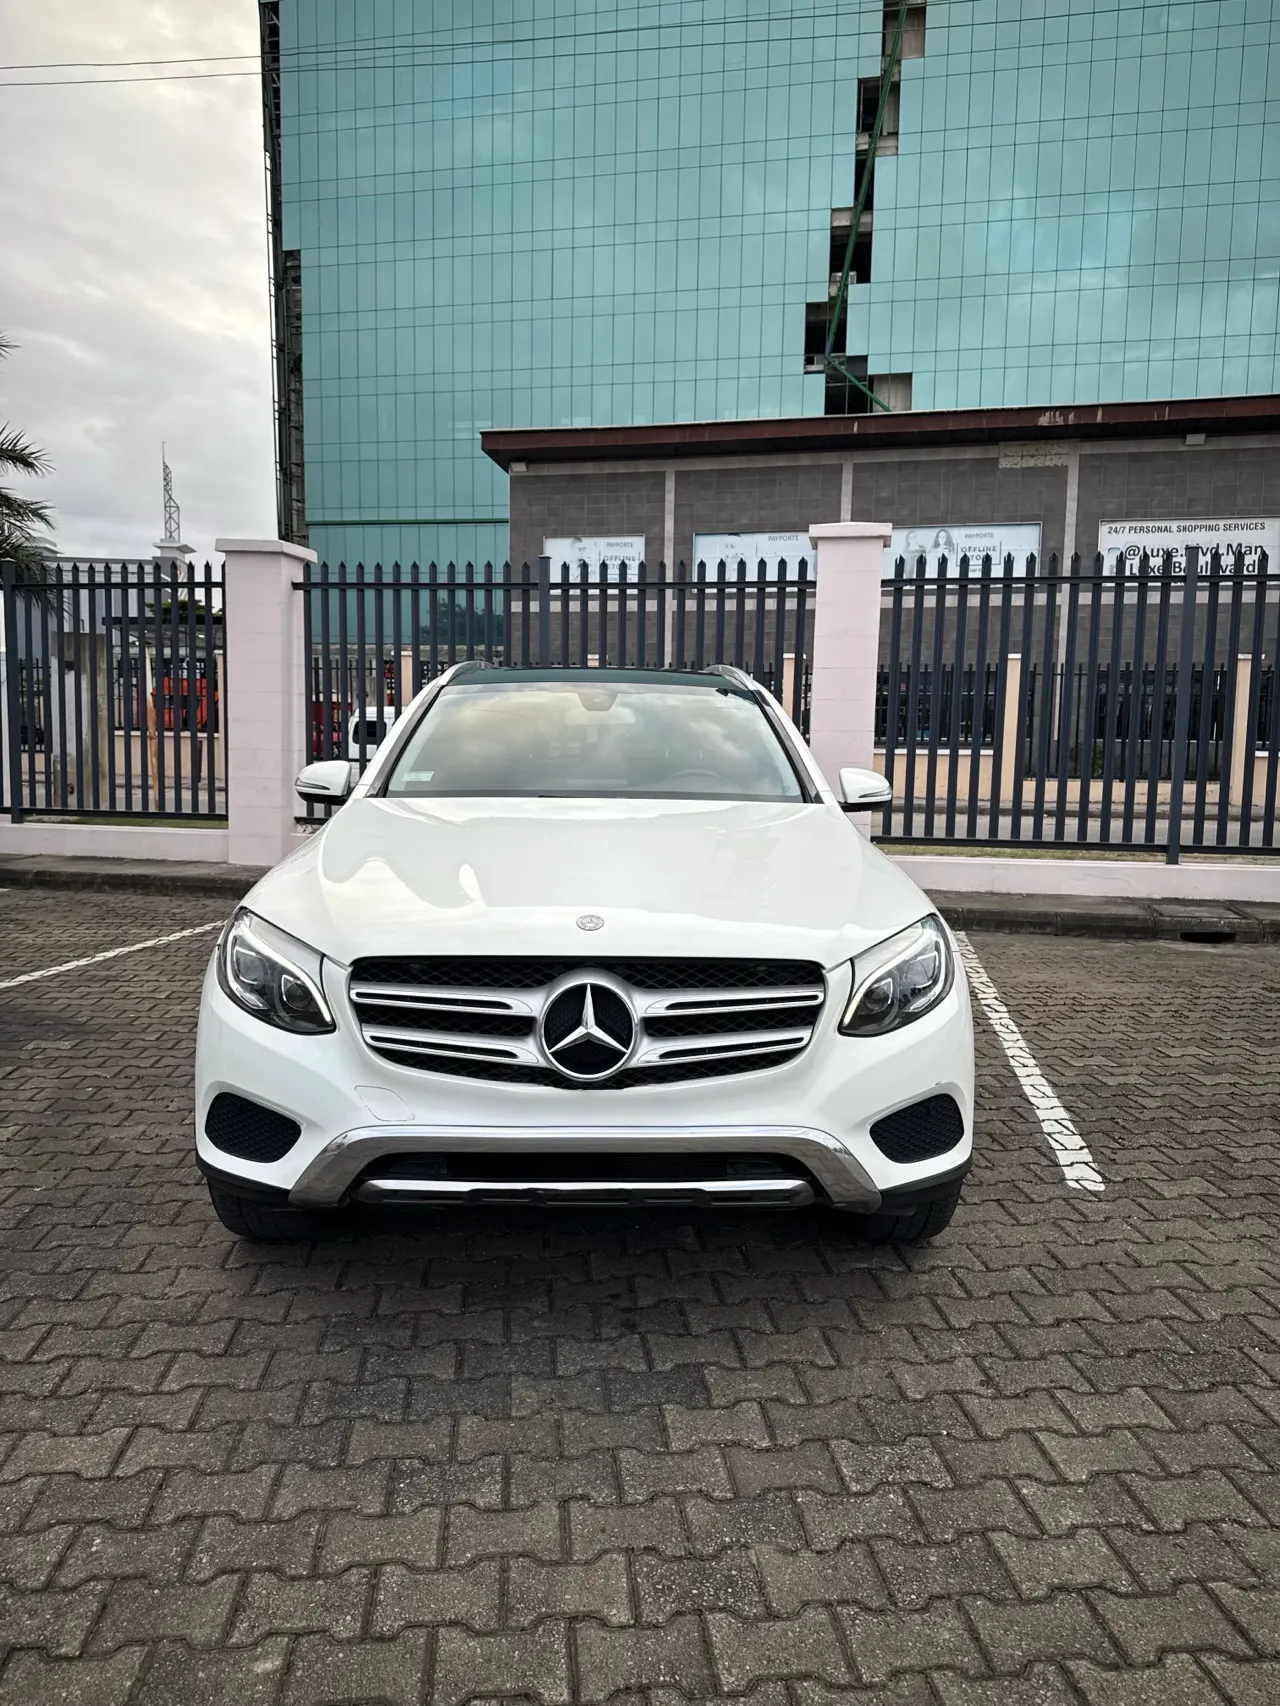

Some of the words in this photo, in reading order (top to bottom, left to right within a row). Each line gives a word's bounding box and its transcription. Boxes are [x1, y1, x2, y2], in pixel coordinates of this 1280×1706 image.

[1108, 526, 1126, 535] 24/7
[1128, 525, 1174, 534] PERSONAL
[1176, 523, 1220, 533] SHOPPING
[1222, 522, 1266, 532] SERVICES
[1129, 562, 1164, 576] Lxe
